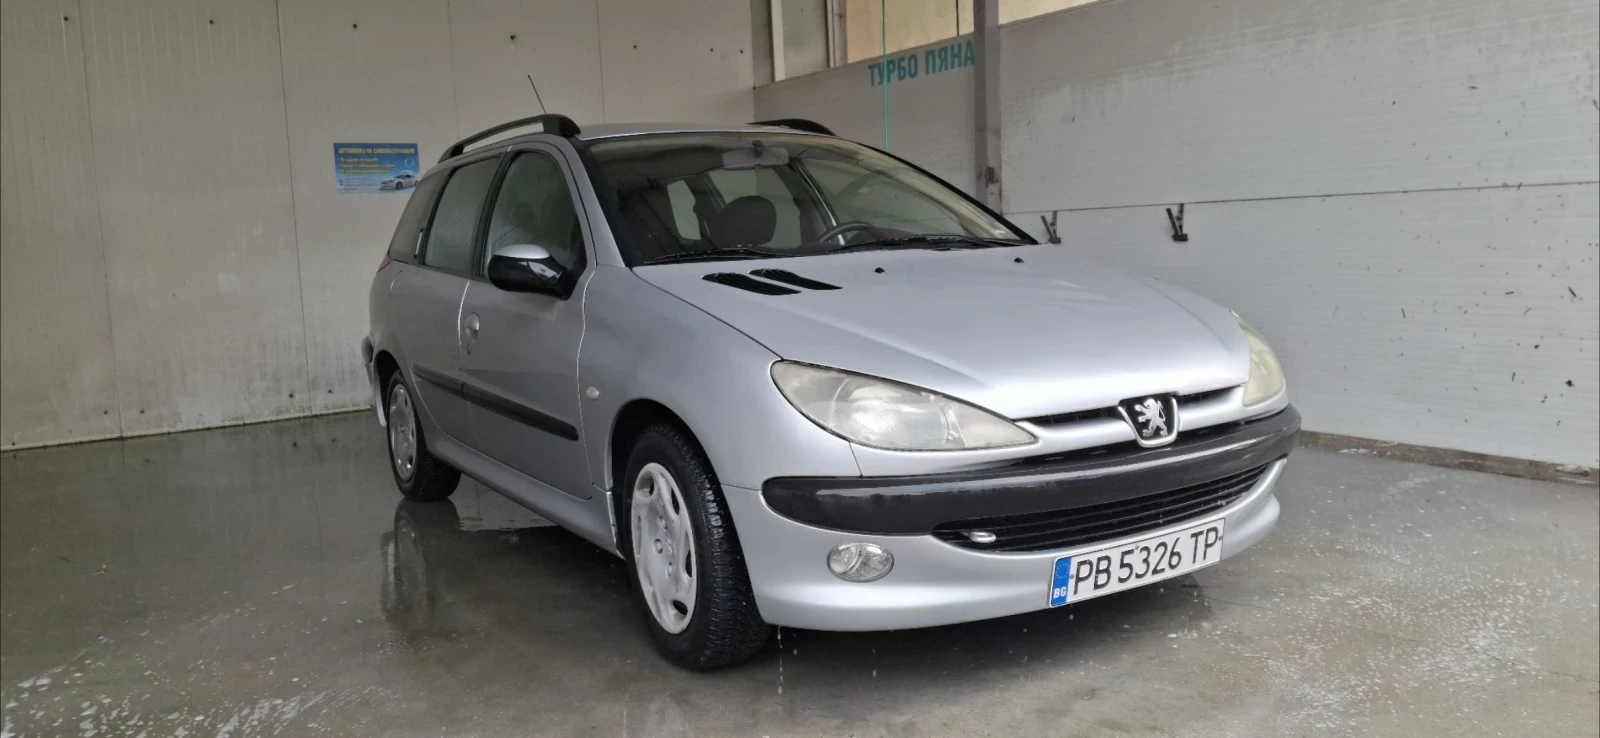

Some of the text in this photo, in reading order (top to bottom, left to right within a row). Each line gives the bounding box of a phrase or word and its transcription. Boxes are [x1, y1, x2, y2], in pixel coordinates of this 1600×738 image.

[868, 40, 975, 87] ТУРБО ПЯНА
[1073, 526, 1219, 595] PB 5326 TP
[1054, 586, 1067, 599] BG
